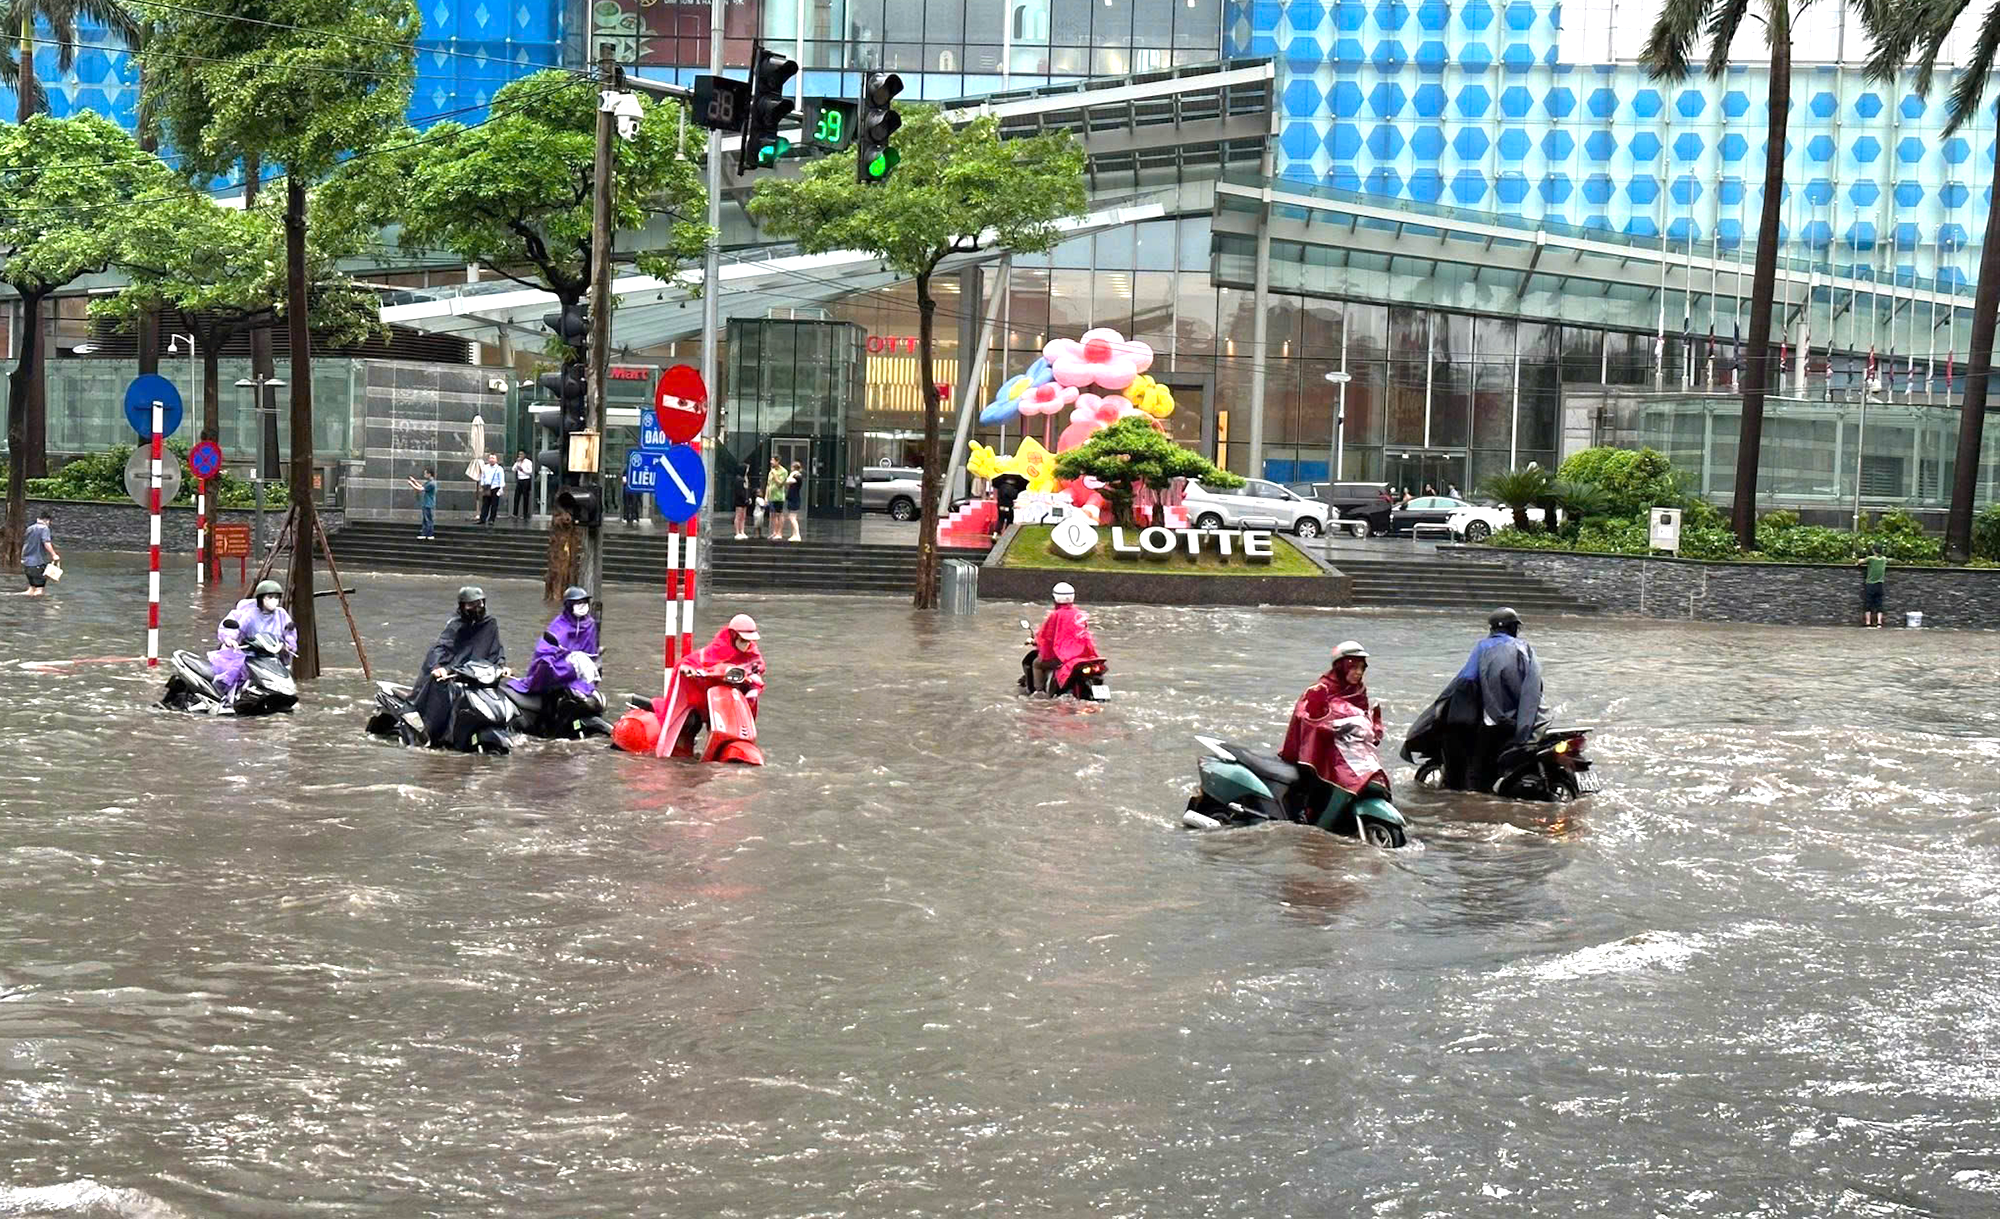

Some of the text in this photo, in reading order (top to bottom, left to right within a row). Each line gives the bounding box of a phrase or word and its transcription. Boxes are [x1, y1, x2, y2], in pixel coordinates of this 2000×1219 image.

[866, 335, 938, 354] OTT
[609, 367, 648, 380] Mart
[645, 427, 666, 444] ĐÀO
[924, 543, 931, 554] 2
[1111, 526, 1274, 557] LOTTE
